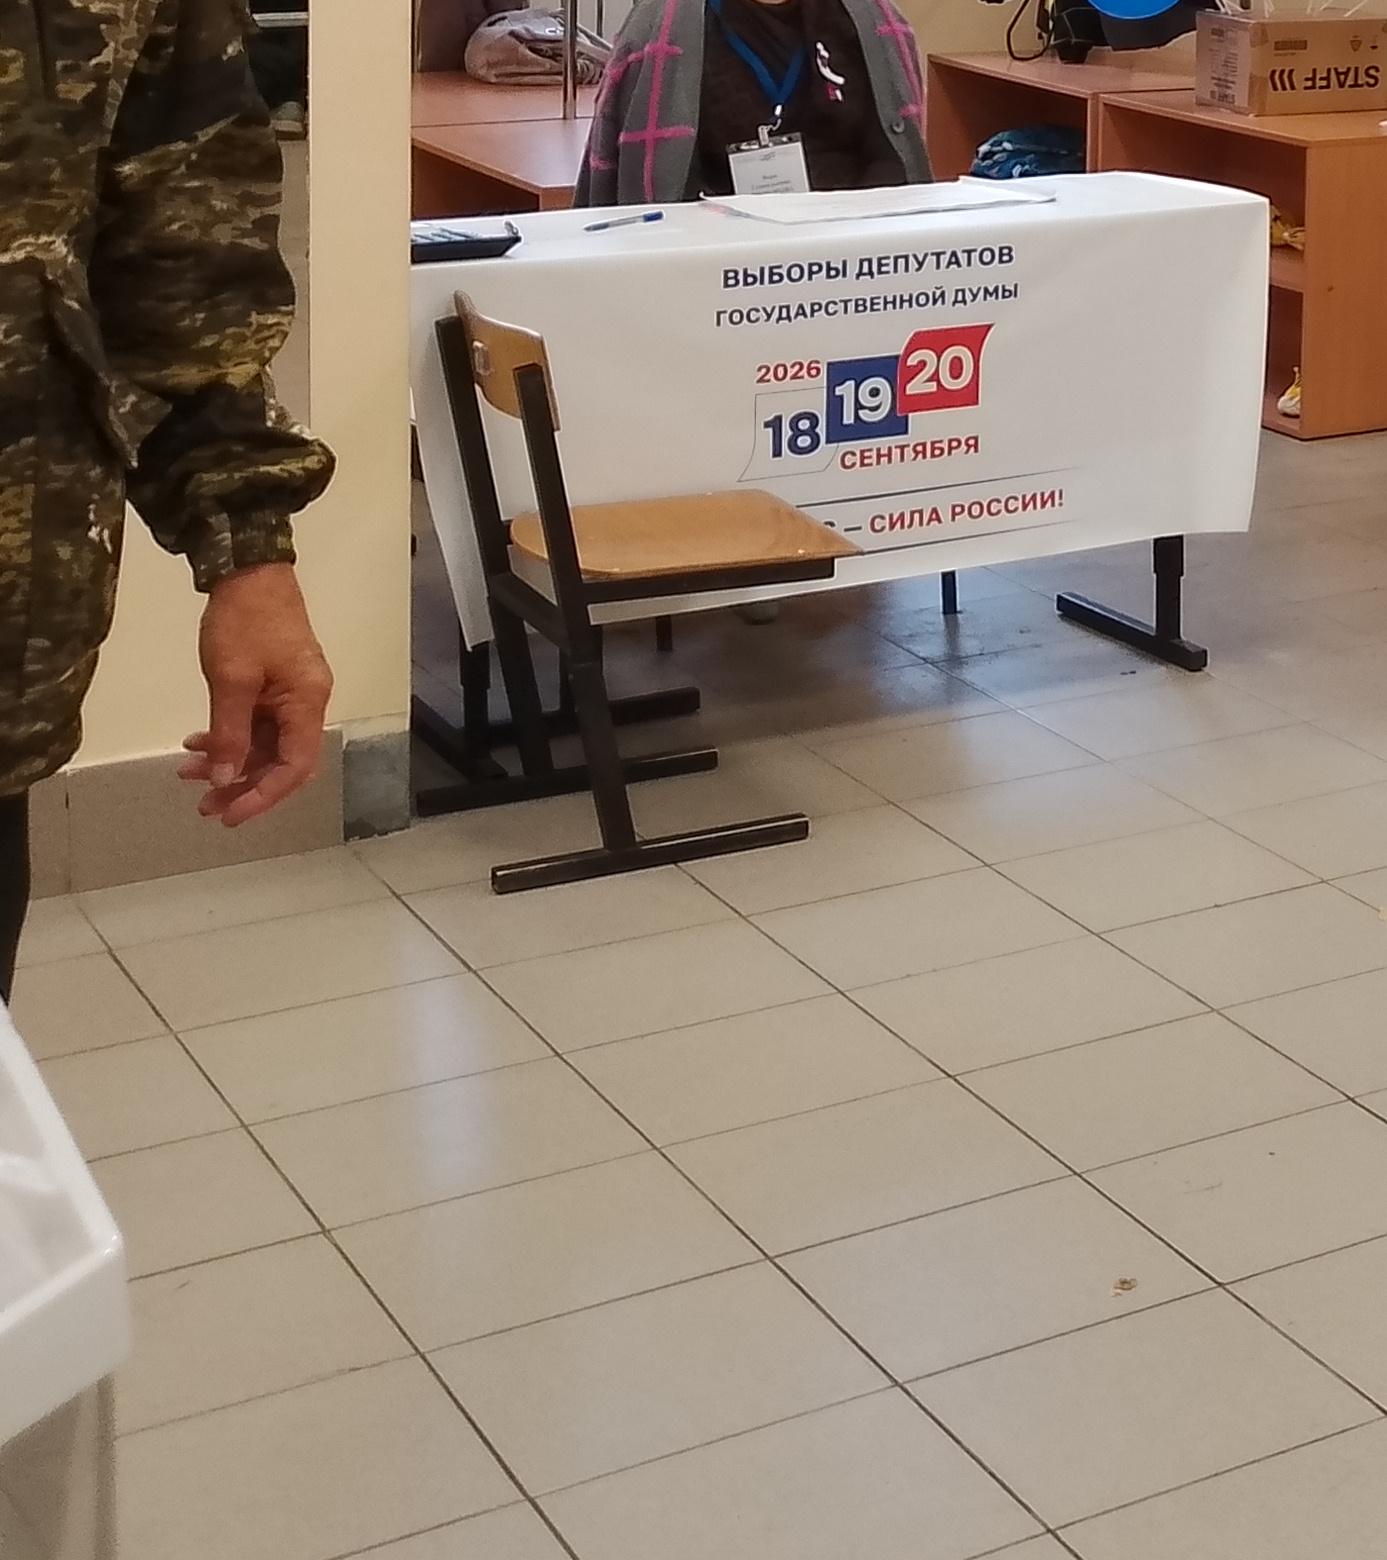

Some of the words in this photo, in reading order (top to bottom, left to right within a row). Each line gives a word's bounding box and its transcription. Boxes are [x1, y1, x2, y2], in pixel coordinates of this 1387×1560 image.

[1303, 66, 1380, 90] STAFF
[723, 260, 848, 289] ВЫБОРЫ
[856, 245, 1014, 280] ДЕПУТАТОВ
[716, 286, 947, 327] ГОСУДАРСТВЕННОЙ
[952, 283, 1018, 308] ДУМЫ
[756, 360, 822, 384] 2026
[763, 412, 821, 459] 18
[834, 377, 892, 426] 19
[906, 345, 974, 395] 20
[840, 436, 980, 471] СЕНТЯБРЯ
[870, 507, 942, 533] СИЛА
[951, 489, 1064, 522] РОССИИ!
